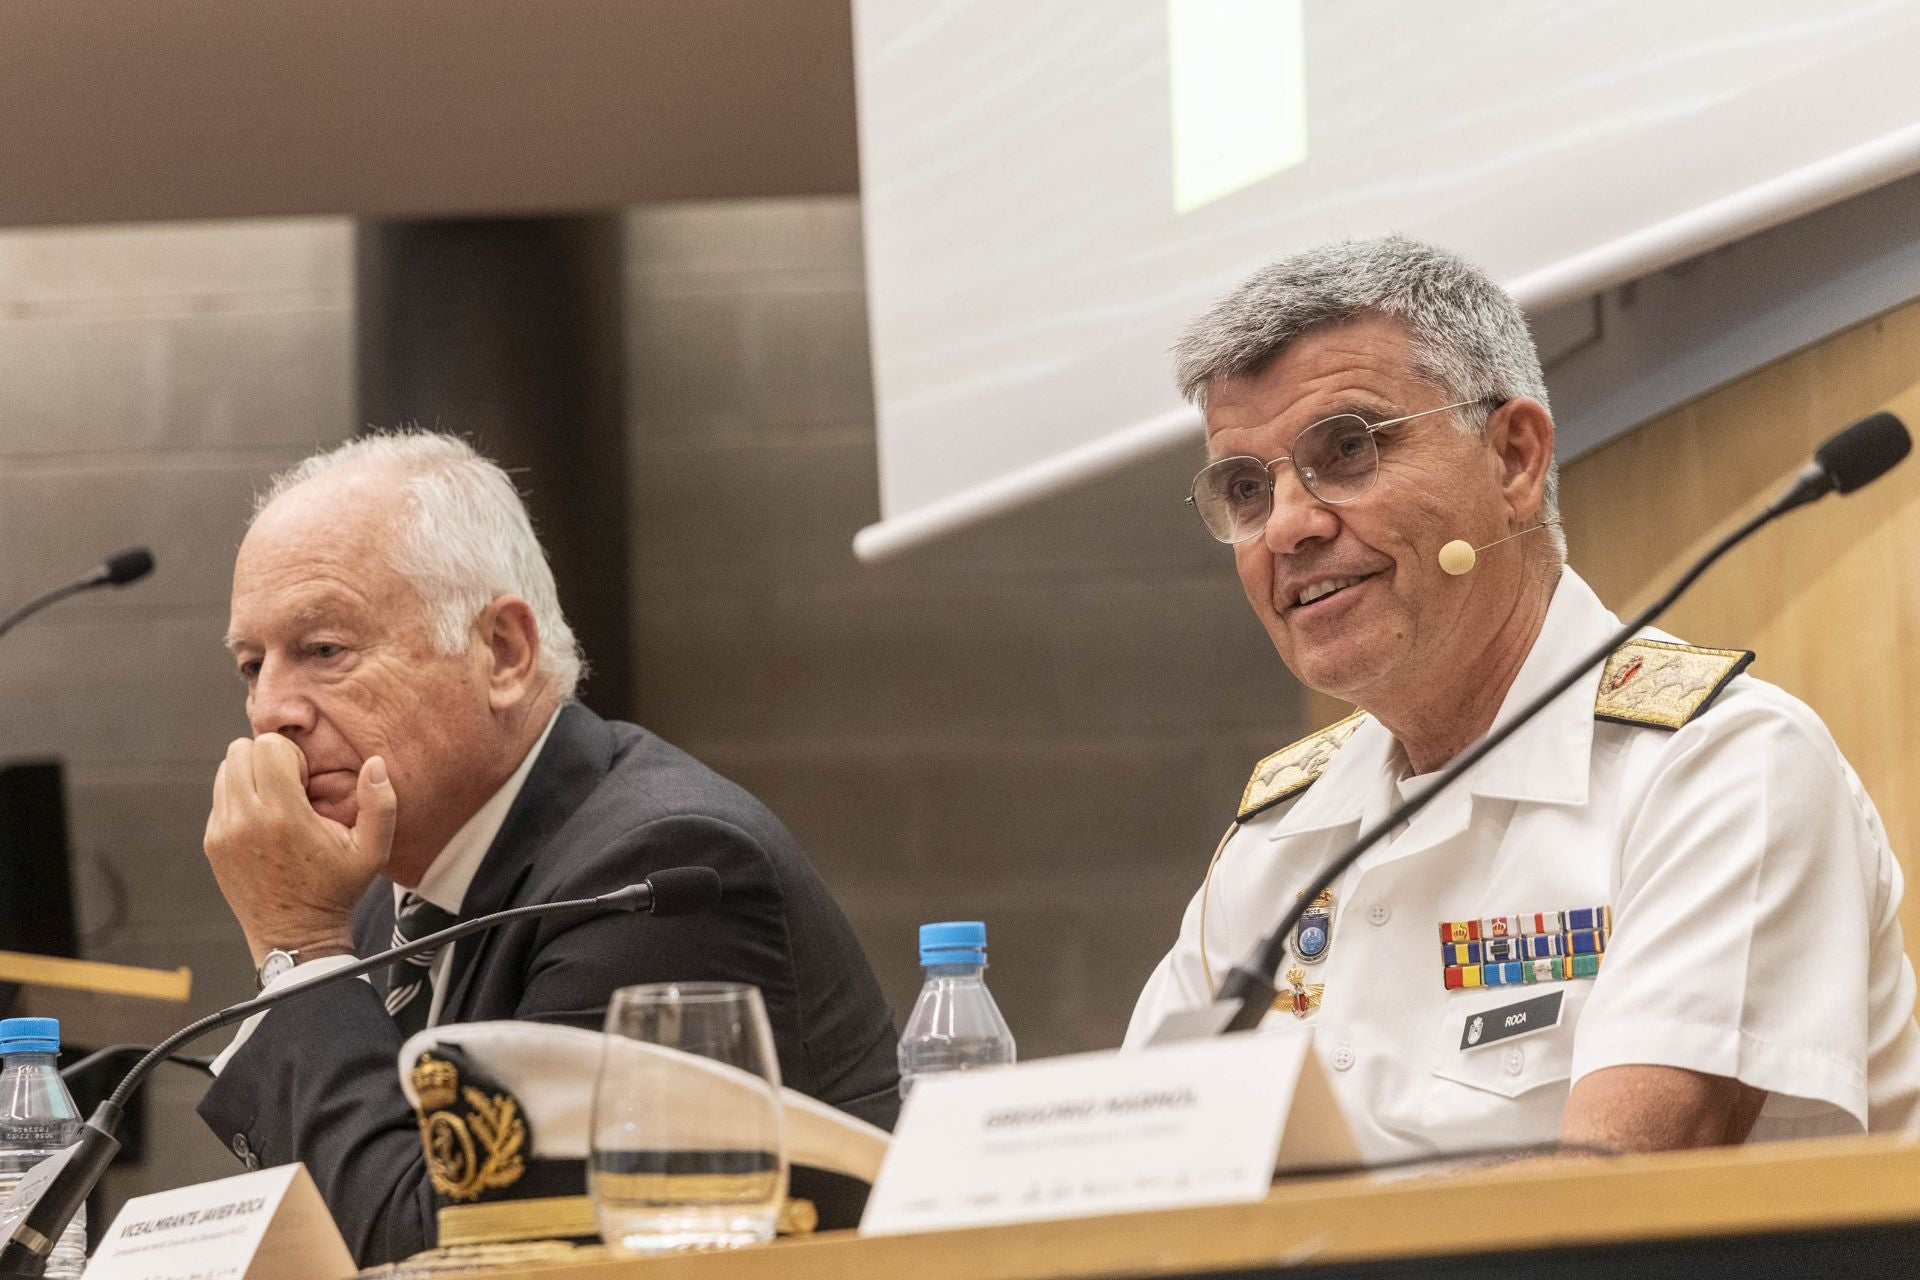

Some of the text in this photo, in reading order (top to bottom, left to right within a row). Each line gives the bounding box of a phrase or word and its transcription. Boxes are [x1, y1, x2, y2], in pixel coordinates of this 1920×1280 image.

[1505, 1011, 1527, 1027] ROCA
[120, 1197, 266, 1239] VICEALMIRANTE JAVIER ROCA
